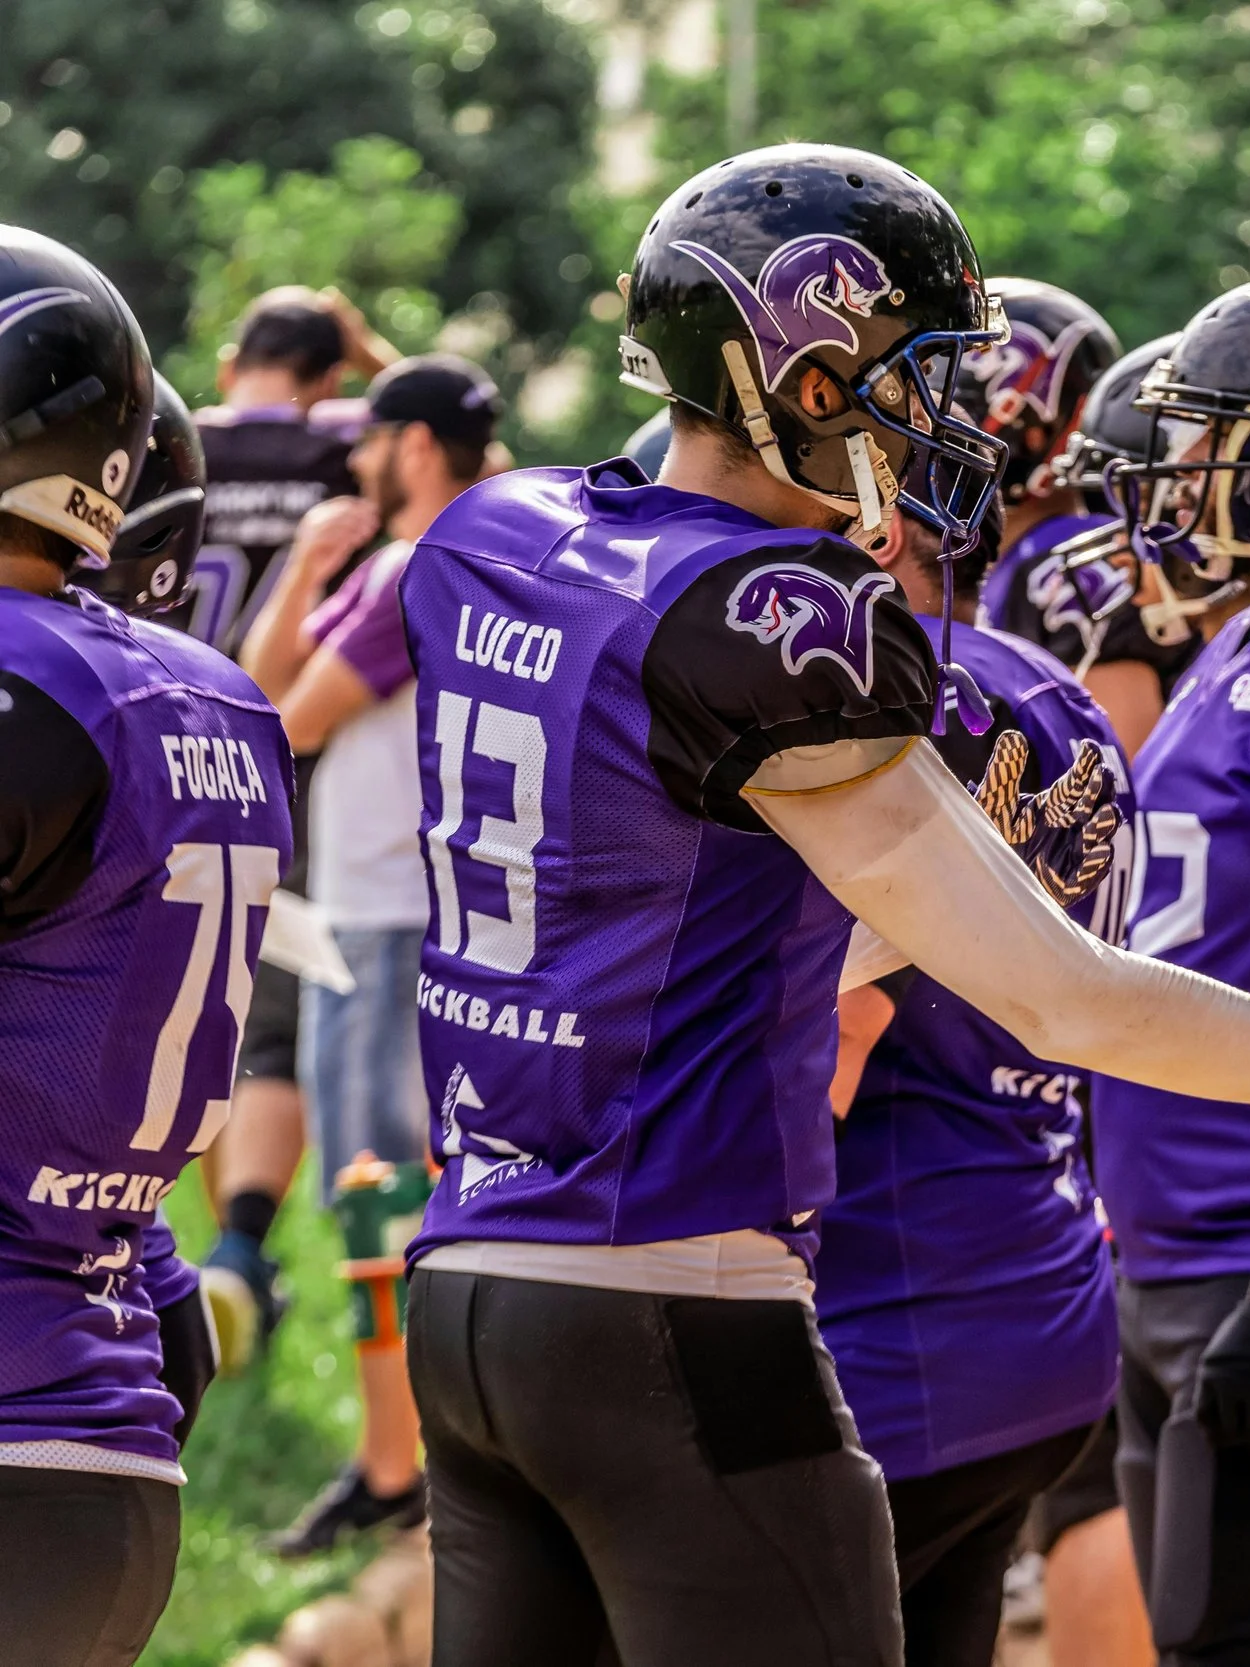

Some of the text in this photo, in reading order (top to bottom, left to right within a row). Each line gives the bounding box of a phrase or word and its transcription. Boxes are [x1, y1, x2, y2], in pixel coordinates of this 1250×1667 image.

[455, 604, 563, 683] LUCCO
[160, 734, 267, 819] FOGAÇA
[427, 690, 548, 975] 13
